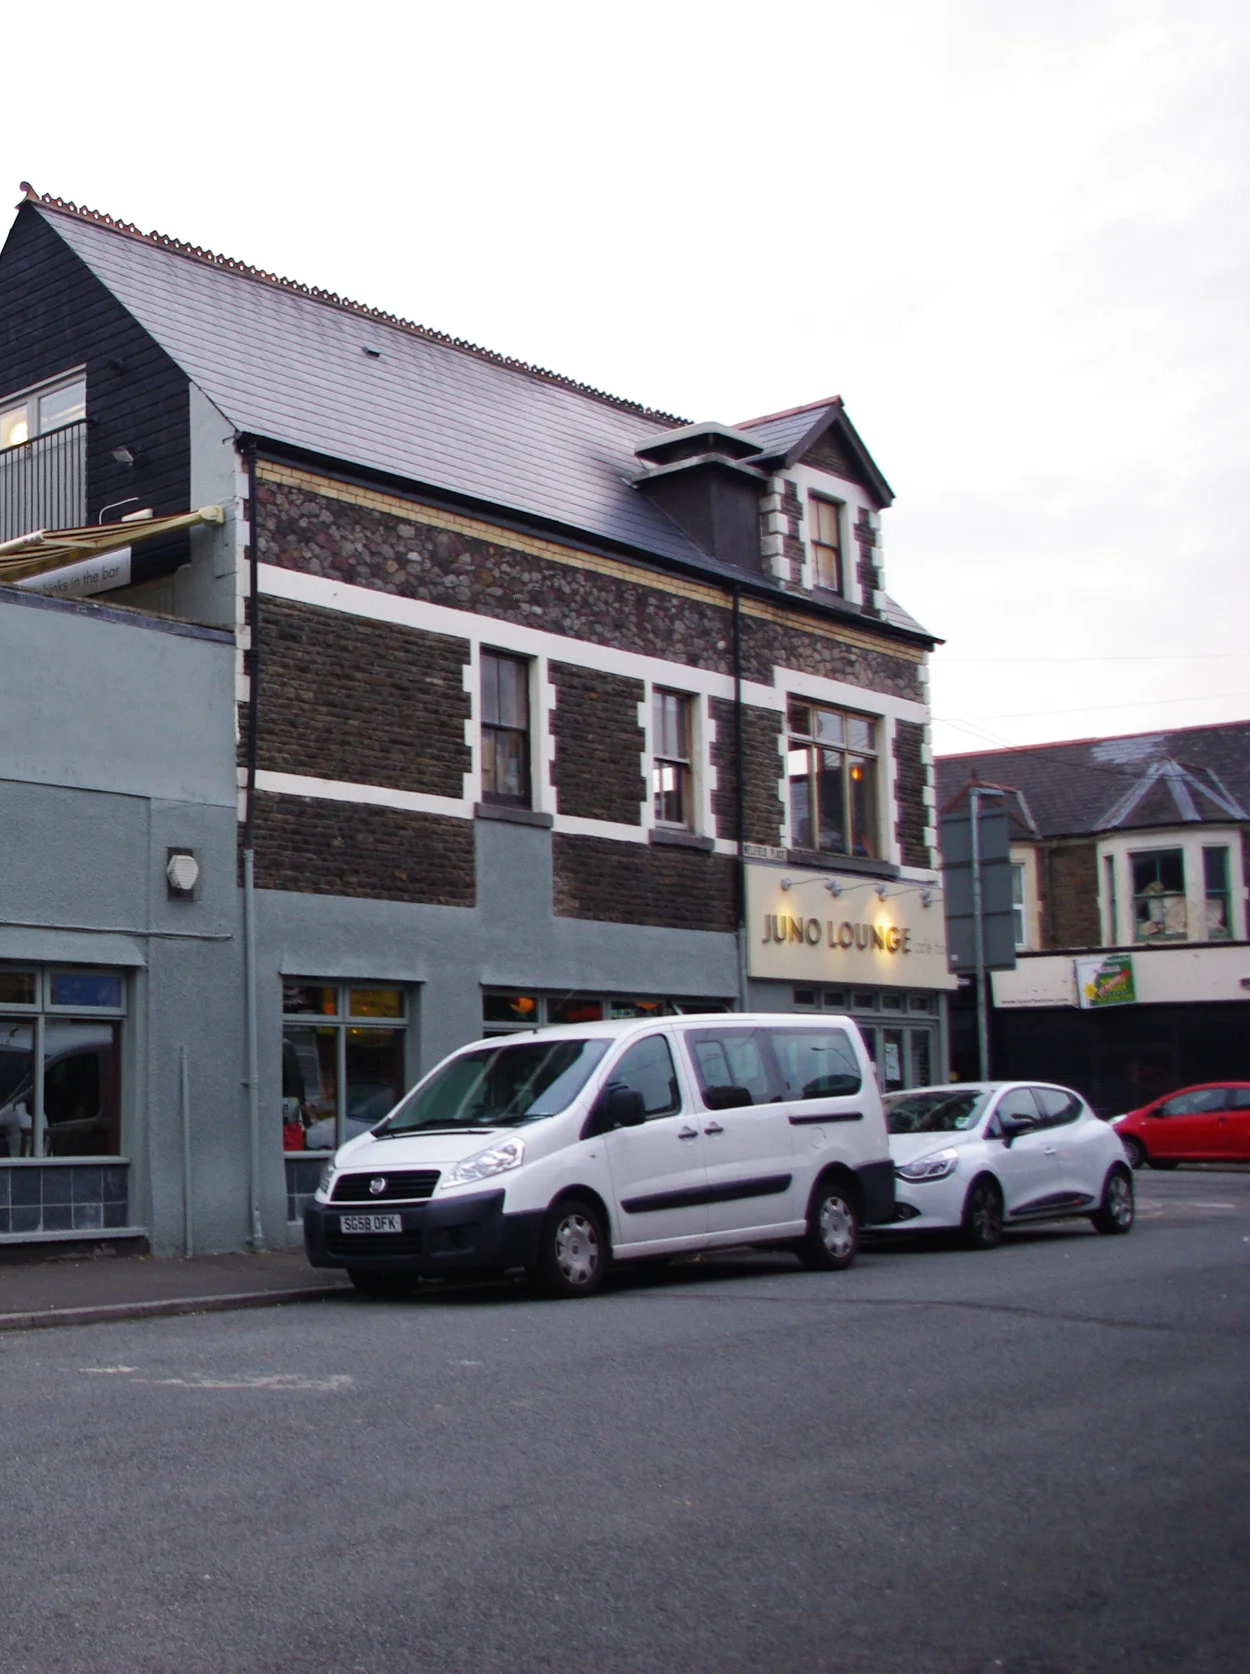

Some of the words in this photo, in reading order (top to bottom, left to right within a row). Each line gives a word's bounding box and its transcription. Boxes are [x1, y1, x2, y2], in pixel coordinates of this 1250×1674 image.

[71, 577, 80, 588] in
[83, 570, 99, 585] the
[102, 564, 120, 581] bar
[762, 914, 821, 946] JUNO
[827, 920, 911, 954] LOUNGE
[344, 1216, 371, 1231] SG58
